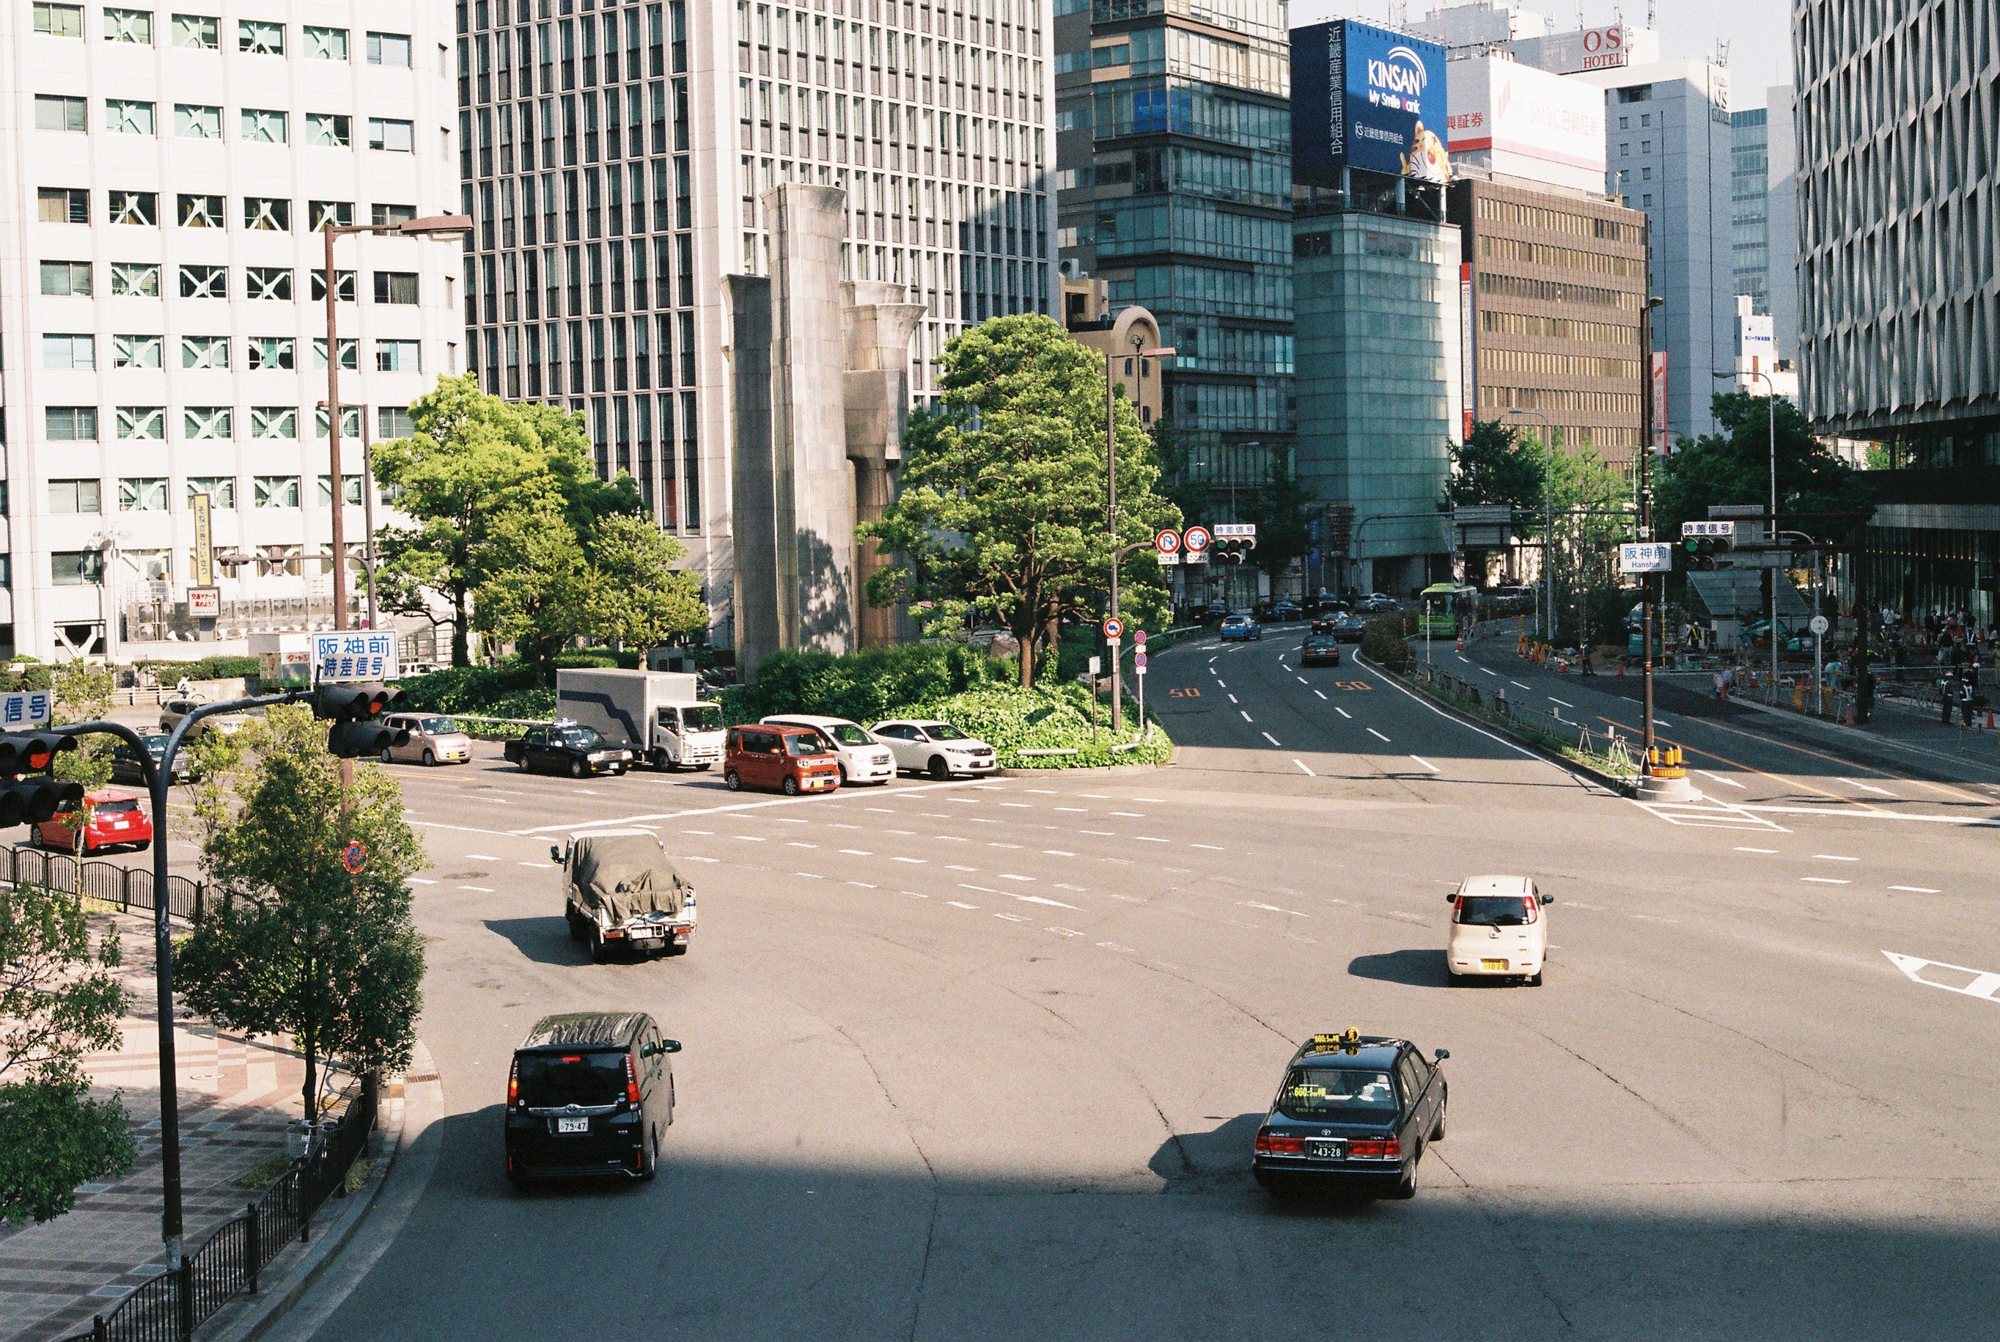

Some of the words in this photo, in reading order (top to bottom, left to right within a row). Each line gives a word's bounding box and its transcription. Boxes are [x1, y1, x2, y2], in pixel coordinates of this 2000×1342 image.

[1583, 27, 1621, 53] OS
[1583, 52, 1623, 69] HOTEL
[1368, 59, 1420, 96] KINSAN
[1328, 25, 1343, 155] 近畿産業信用組合
[1369, 89, 1380, 107] My
[1381, 92, 1400, 109] Smile
[1402, 97, 1420, 114] Bank
[1364, 126, 1403, 145] 近畿産業信用組合
[1216, 525, 1254, 534] 時差信号
[1684, 523, 1730, 534] 時差信号
[1190, 534, 1205, 546] 50
[1624, 544, 1667, 560] 阪神前
[1631, 561, 1660, 569] Hanshin
[318, 636, 390, 660] 阪神前
[324, 657, 383, 677] 時差信号
[1169, 687, 1201, 698] 50
[1335, 681, 1373, 691] 50
[4, 694, 47, 723] 信号
